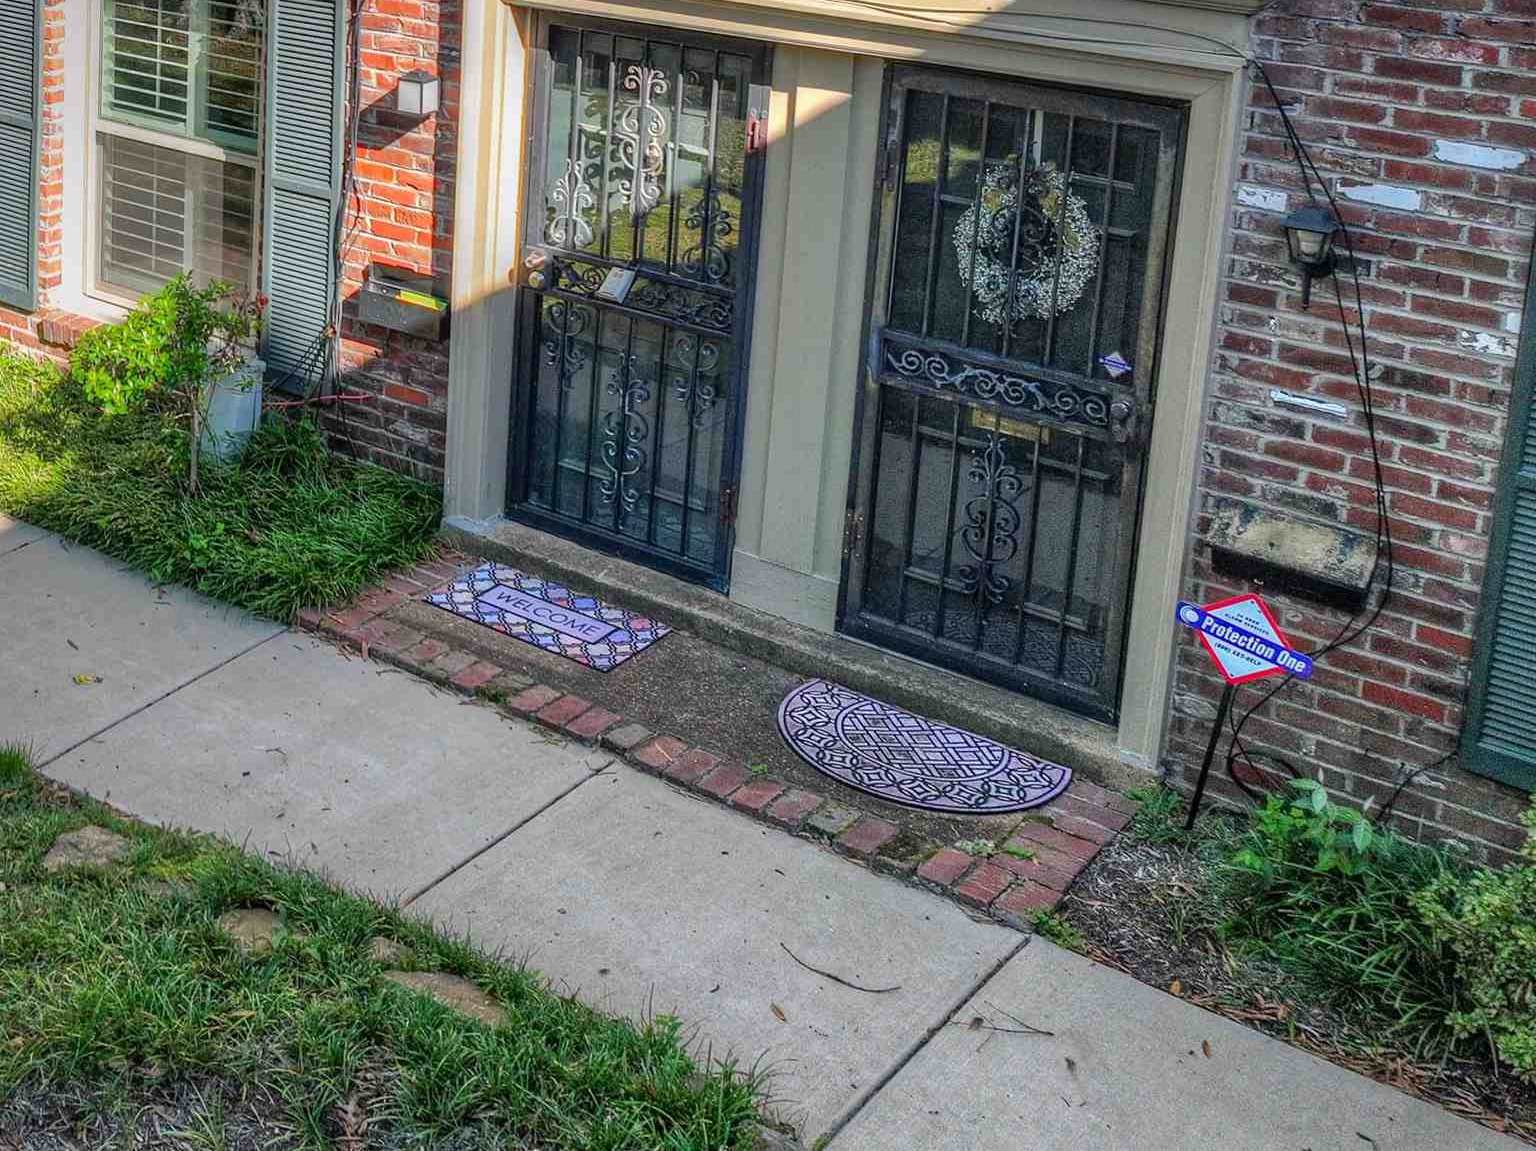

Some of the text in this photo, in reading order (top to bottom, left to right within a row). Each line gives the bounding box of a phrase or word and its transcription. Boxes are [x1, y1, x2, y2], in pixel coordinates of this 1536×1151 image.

[496, 590, 601, 637] WELCOME
[1201, 615, 1275, 660] Protection
[1276, 648, 1306, 673] One
